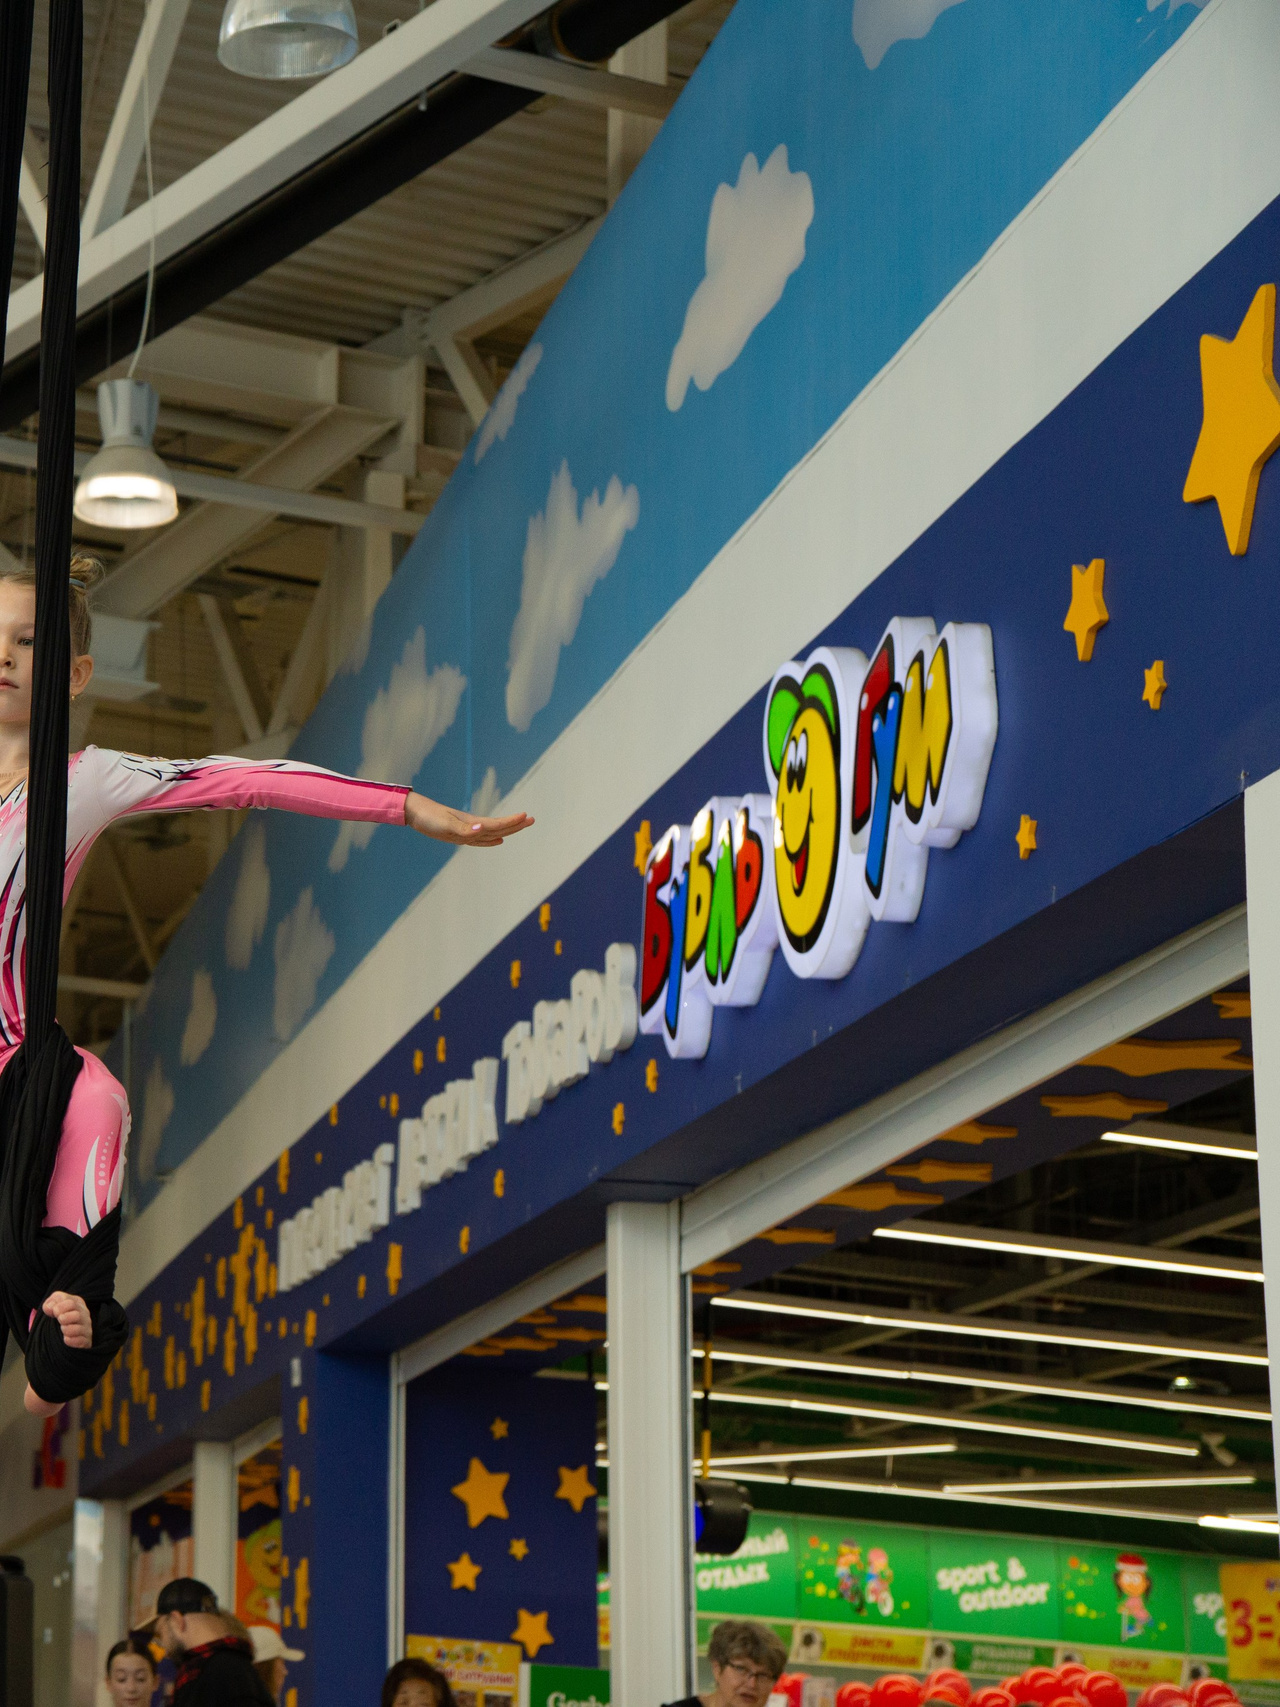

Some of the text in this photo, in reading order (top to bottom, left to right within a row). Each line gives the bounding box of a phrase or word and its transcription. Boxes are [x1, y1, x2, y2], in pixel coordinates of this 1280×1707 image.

[936, 1556, 1027, 1594] sport &
[959, 1582, 1050, 1613] outdoor
